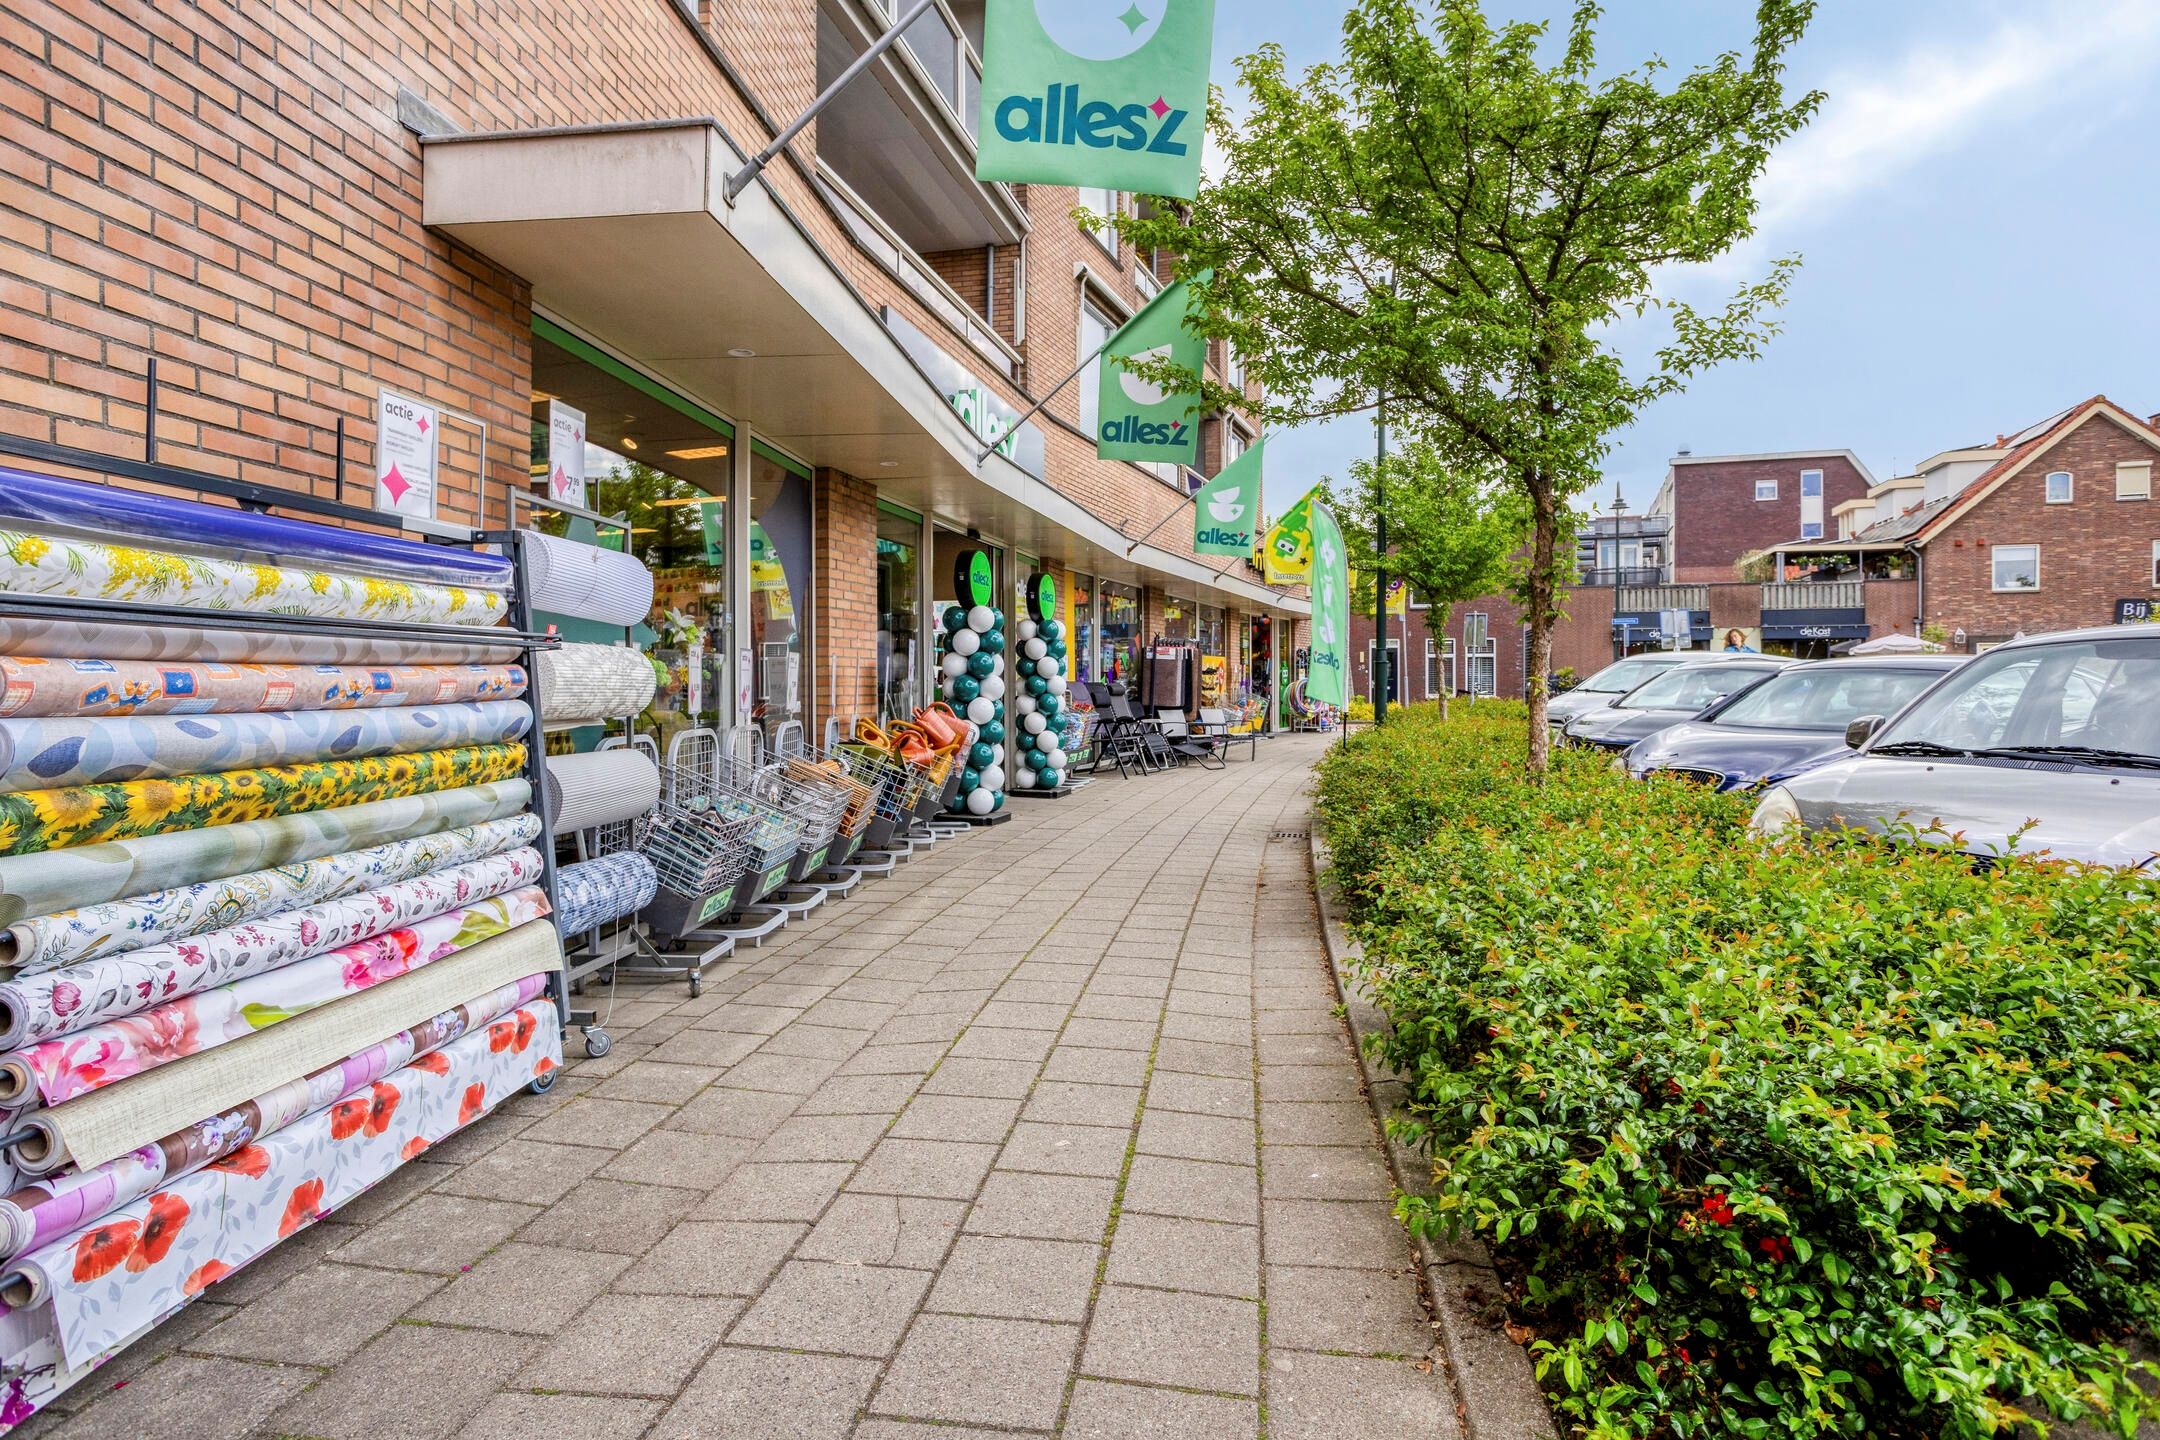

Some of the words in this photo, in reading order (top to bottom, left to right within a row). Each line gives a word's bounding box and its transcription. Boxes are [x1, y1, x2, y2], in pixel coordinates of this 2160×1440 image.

[385, 402, 414, 421] actie
[554, 418, 572, 433] actie
[2123, 603, 2147, 619] Bij
